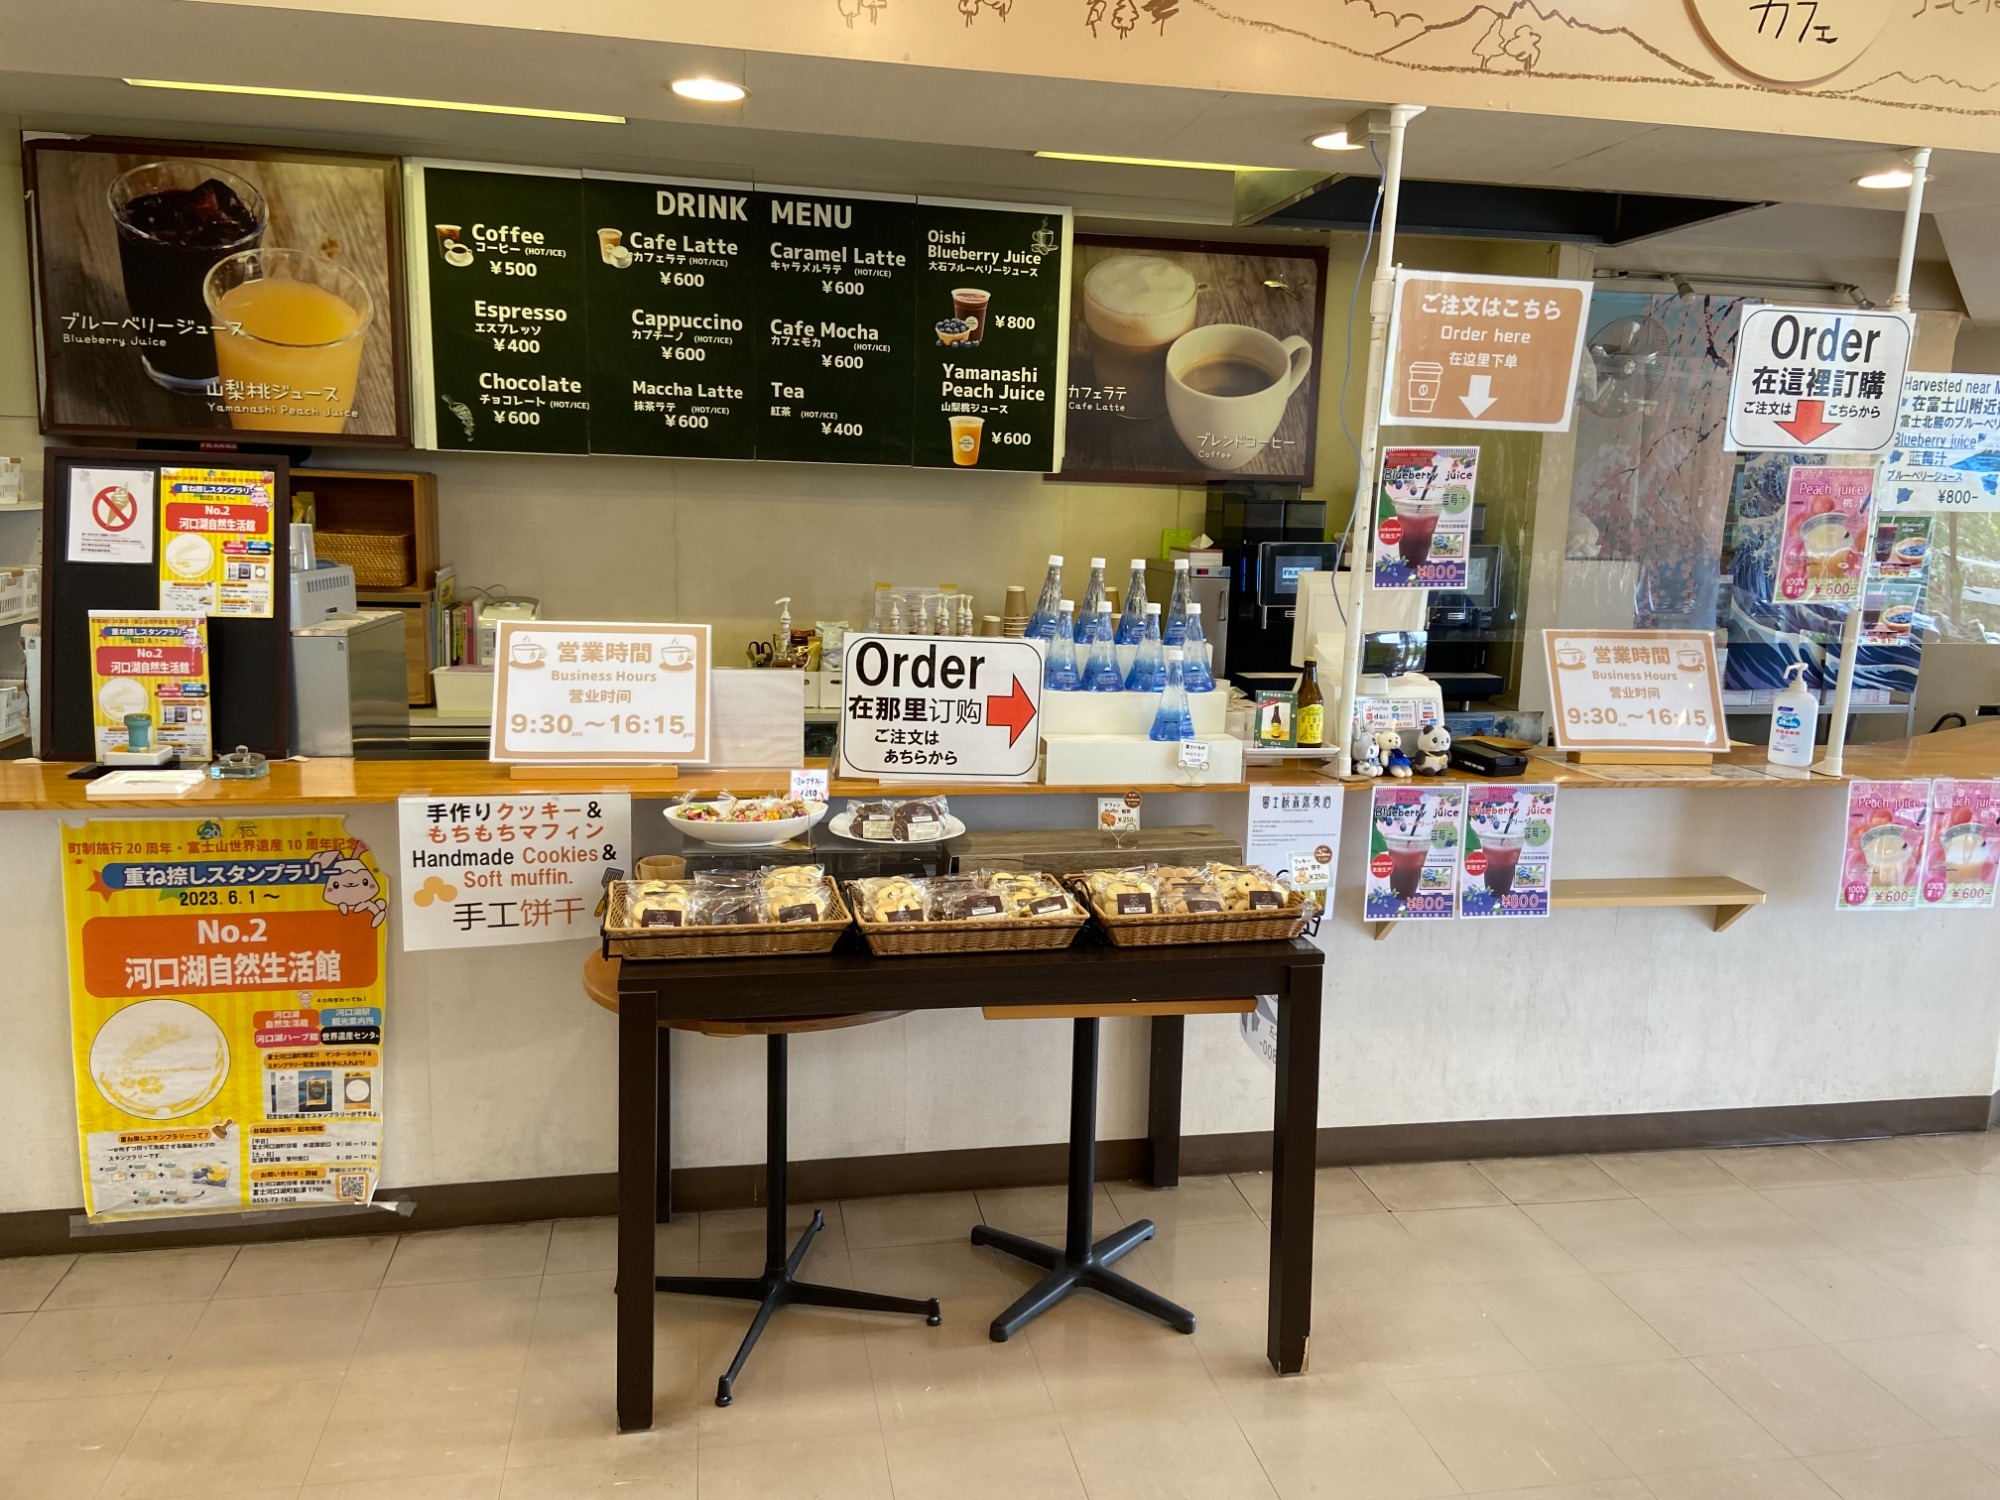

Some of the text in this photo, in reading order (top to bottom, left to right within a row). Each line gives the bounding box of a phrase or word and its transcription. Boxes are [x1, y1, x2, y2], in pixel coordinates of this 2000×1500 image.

[656, 190, 852, 229] DRINK MENU
[472, 223, 544, 245] Coffee
[928, 230, 966, 245] Oishi
[476, 242, 521, 254] コーヒー
[630, 232, 738, 256] Cafe Latte
[633, 251, 686, 265] カフェラテ
[770, 242, 906, 267] Caramel Latte
[928, 245, 1041, 266] Blueberry Juice
[490, 260, 537, 278] ¥500
[771, 260, 842, 275] キャラメルラテ
[928, 261, 1038, 277] 大石ブルーベリージュース
[660, 271, 704, 287] ¥600
[822, 280, 864, 296] ¥600
[474, 300, 567, 322] Espresso
[1421, 292, 1562, 321] ご注文はこちら
[61, 312, 247, 337] ブルーベリージュース
[475, 322, 542, 336] エスプレッソ
[632, 309, 743, 332] Cappuccino
[995, 315, 1036, 330] ¥800
[632, 329, 683, 342] カプチーノ
[770, 319, 879, 341] Cafe Mocha
[1440, 325, 1531, 344] Order here
[1770, 314, 1881, 363] Order
[62, 333, 168, 348] Blueberry Juice
[493, 337, 540, 354] ¥400
[771, 336, 821, 348] カフェモカ
[661, 346, 706, 362] ¥600
[821, 354, 864, 369] ¥600
[1449, 351, 1518, 369] 在这里下单
[942, 362, 1038, 384] Yamanashi
[206, 379, 341, 402] 山梨桃ジュース
[479, 372, 582, 393] Chocolate
[632, 380, 743, 399] Maccha Latte
[771, 382, 805, 399] Tea
[1751, 366, 1886, 401] 在這裡訂購
[1904, 376, 1963, 393] Harvested
[1965, 382, 1991, 395] near
[942, 381, 1045, 402] Peach Juice
[1067, 384, 1127, 401] カフェラテ
[479, 394, 546, 408] チョコレート
[941, 401, 1009, 415] 山梨桃ジュース
[1068, 401, 1126, 412] Cafe Latte
[1912, 395, 2000, 416] 在富士山附近
[207, 402, 360, 419] Yamanashi Peach Juice
[494, 410, 540, 426] ¥600
[1743, 401, 1881, 419] ご注文は こちらから
[664, 414, 709, 429] ¥600
[821, 421, 863, 437] ¥400
[991, 431, 1032, 446] ¥600
[1197, 431, 1296, 449] ブレンドコーヒー
[1950, 434, 1977, 449] juice
[1198, 450, 1232, 460] Coffee
[1799, 482, 1865, 498] Peach juice
[205, 505, 230, 516] No.2
[179, 517, 256, 532] 河口湖自然生活館
[137, 648, 163, 658] No.2
[557, 641, 653, 664] 営業時間
[1592, 645, 1671, 666] 営業時間
[111, 661, 190, 674] 河口湖自然生活館
[856, 641, 985, 690] Order
[550, 669, 657, 683] Business Hours
[1592, 670, 1678, 682] Business Hours
[568, 689, 632, 704] 营业时间
[1609, 686, 1660, 700] 营业时间
[848, 695, 982, 725] 在那里订购
[874, 728, 940, 746] ご注文は
[883, 749, 958, 765] あちらから
[1858, 796, 1889, 809] Peach
[428, 823, 604, 844] もちもちマフィン
[412, 847, 514, 868] Handmade
[124, 863, 340, 887] 重ね捺しスタンプラリー
[463, 869, 573, 888] Soft muffin.
[452, 897, 586, 931] 手工饼干
[197, 918, 268, 944] No.2
[125, 950, 341, 990] 河口湖自然生活館
